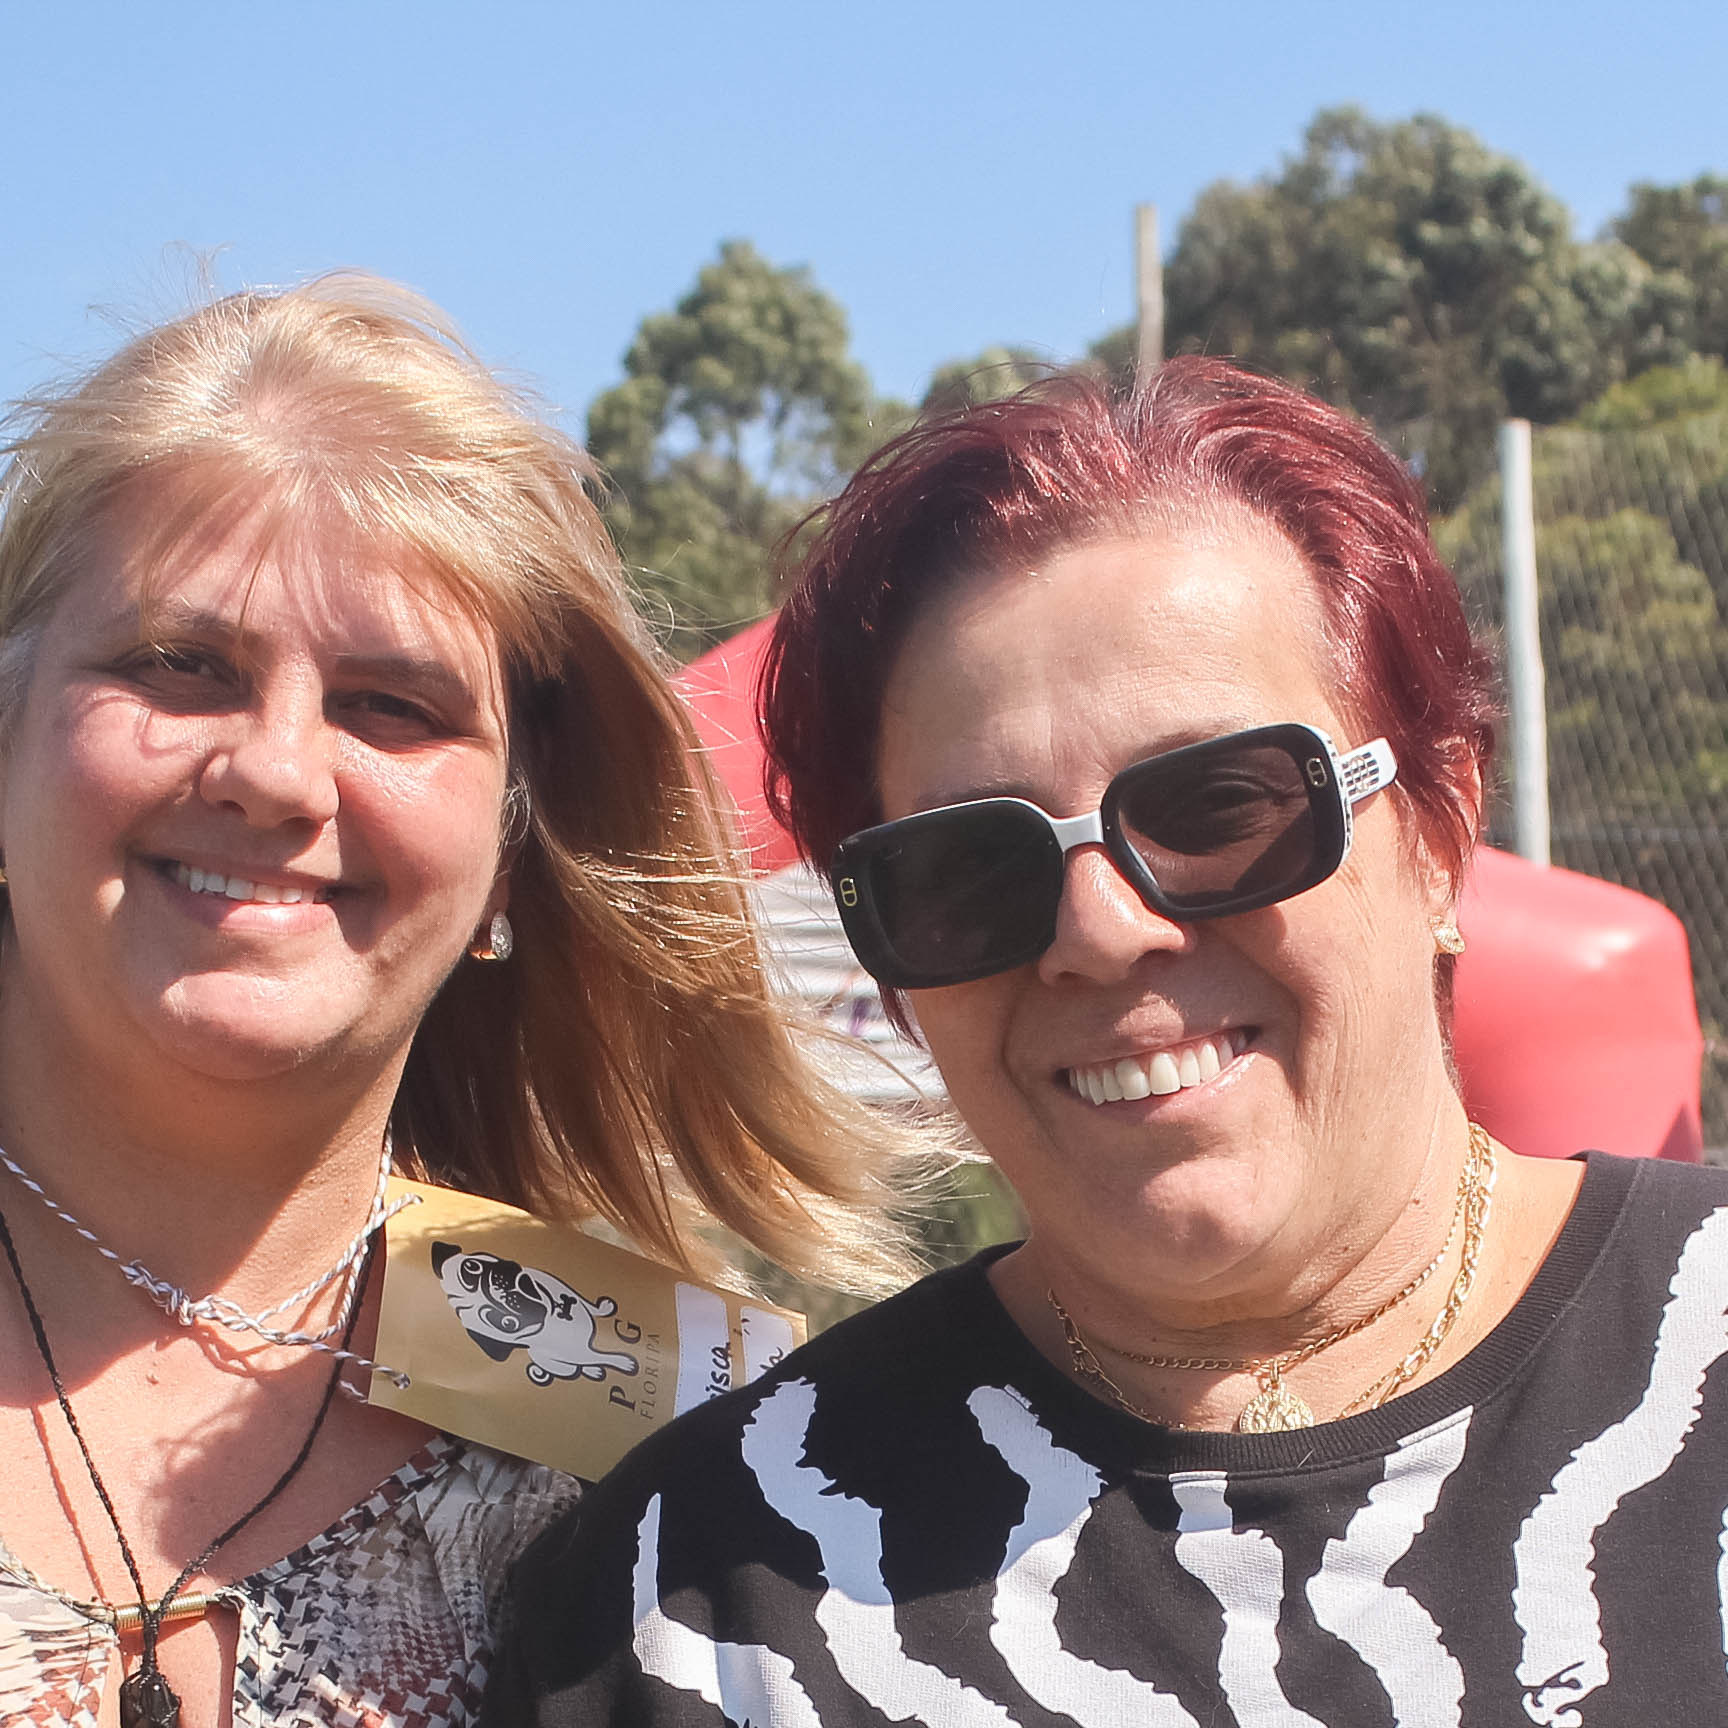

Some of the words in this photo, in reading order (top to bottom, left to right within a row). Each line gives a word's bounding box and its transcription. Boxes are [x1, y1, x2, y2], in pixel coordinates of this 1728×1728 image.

[609, 1318, 642, 1412] PG
[639, 1332, 661, 1420] FLORIPA
[703, 1341, 732, 1399] isca
